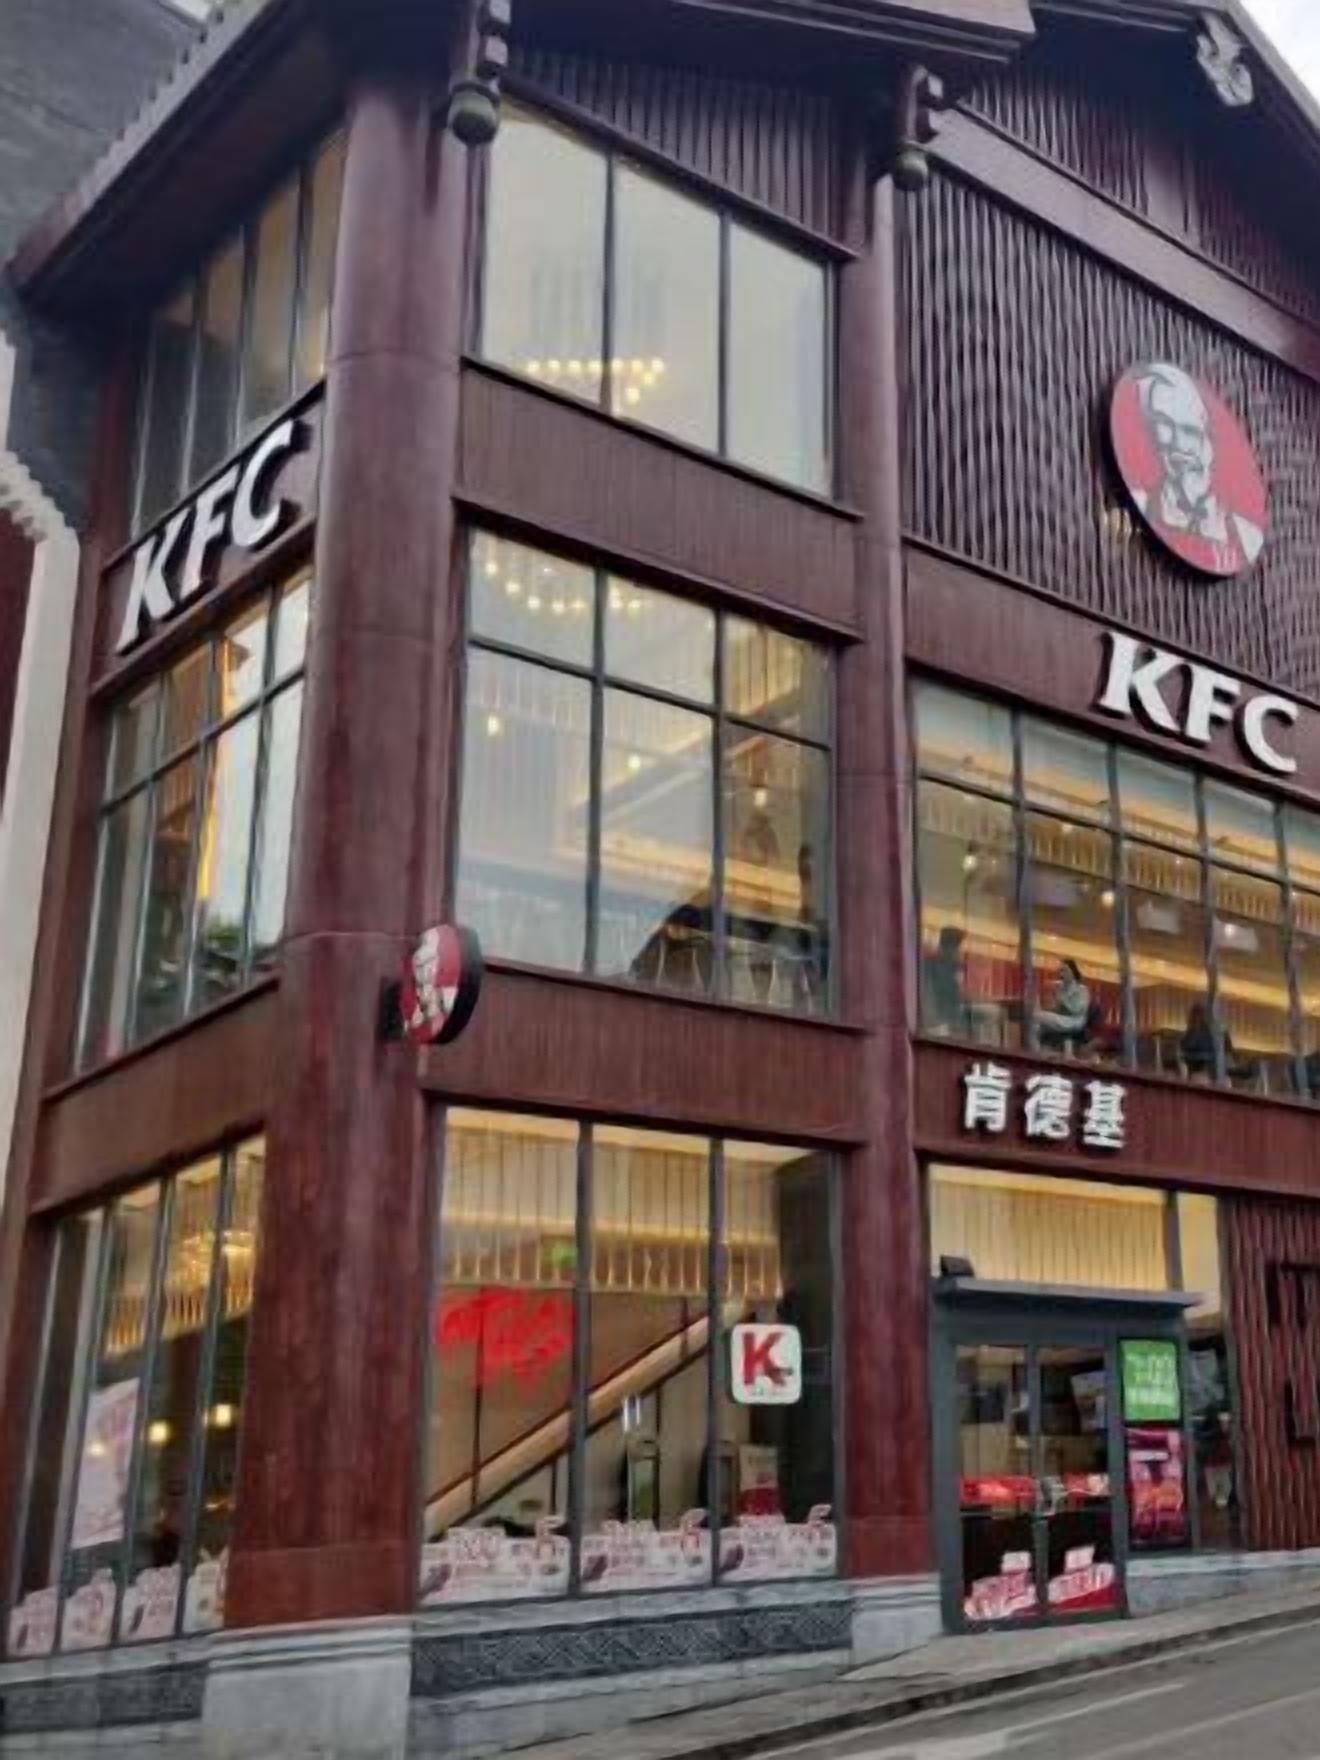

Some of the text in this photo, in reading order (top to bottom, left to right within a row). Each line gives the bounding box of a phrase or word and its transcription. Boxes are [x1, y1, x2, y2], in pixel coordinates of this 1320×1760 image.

[116, 419, 304, 655] KFC
[1098, 631, 1299, 773] KFC
[963, 1062, 1126, 1148] 肯德基
